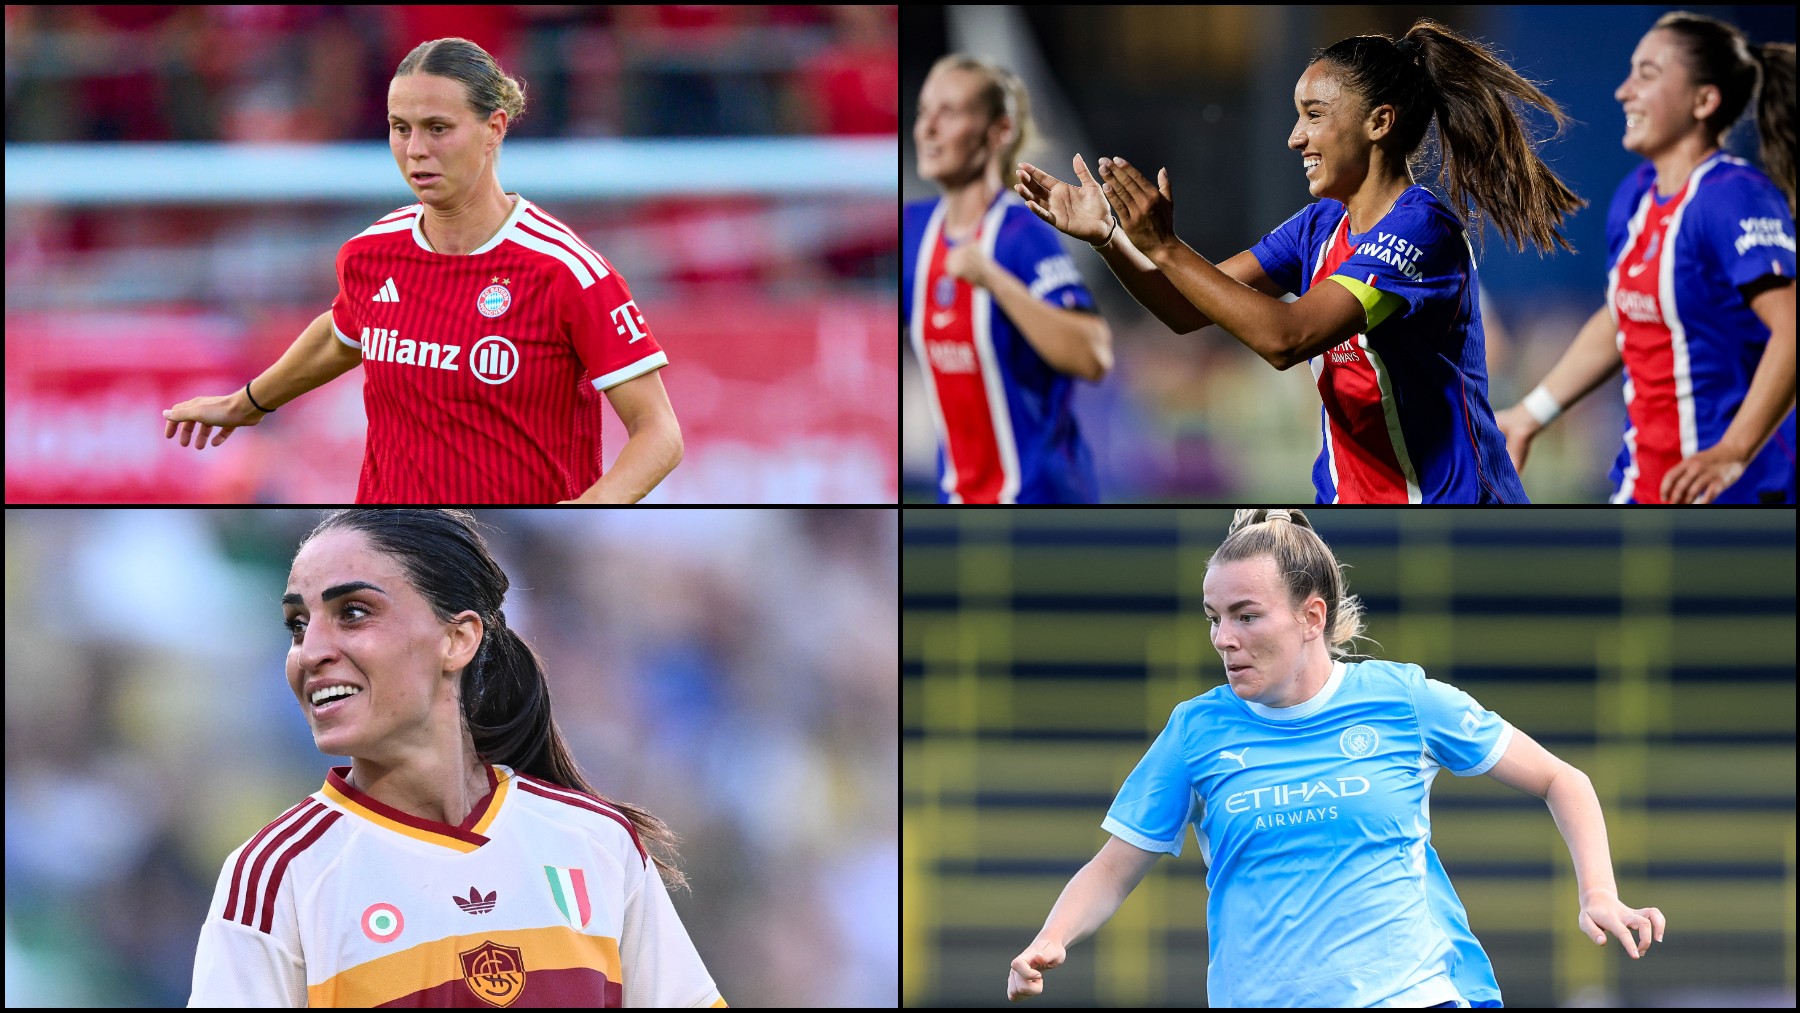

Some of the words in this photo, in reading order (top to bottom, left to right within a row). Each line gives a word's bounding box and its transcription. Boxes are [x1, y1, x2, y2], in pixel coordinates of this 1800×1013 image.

[1377, 232, 1424, 262] VISIT
[360, 327, 461, 371] Allianz
[1225, 775, 1371, 814] ETIHAD
[1255, 806, 1339, 830] AIRWAYS
